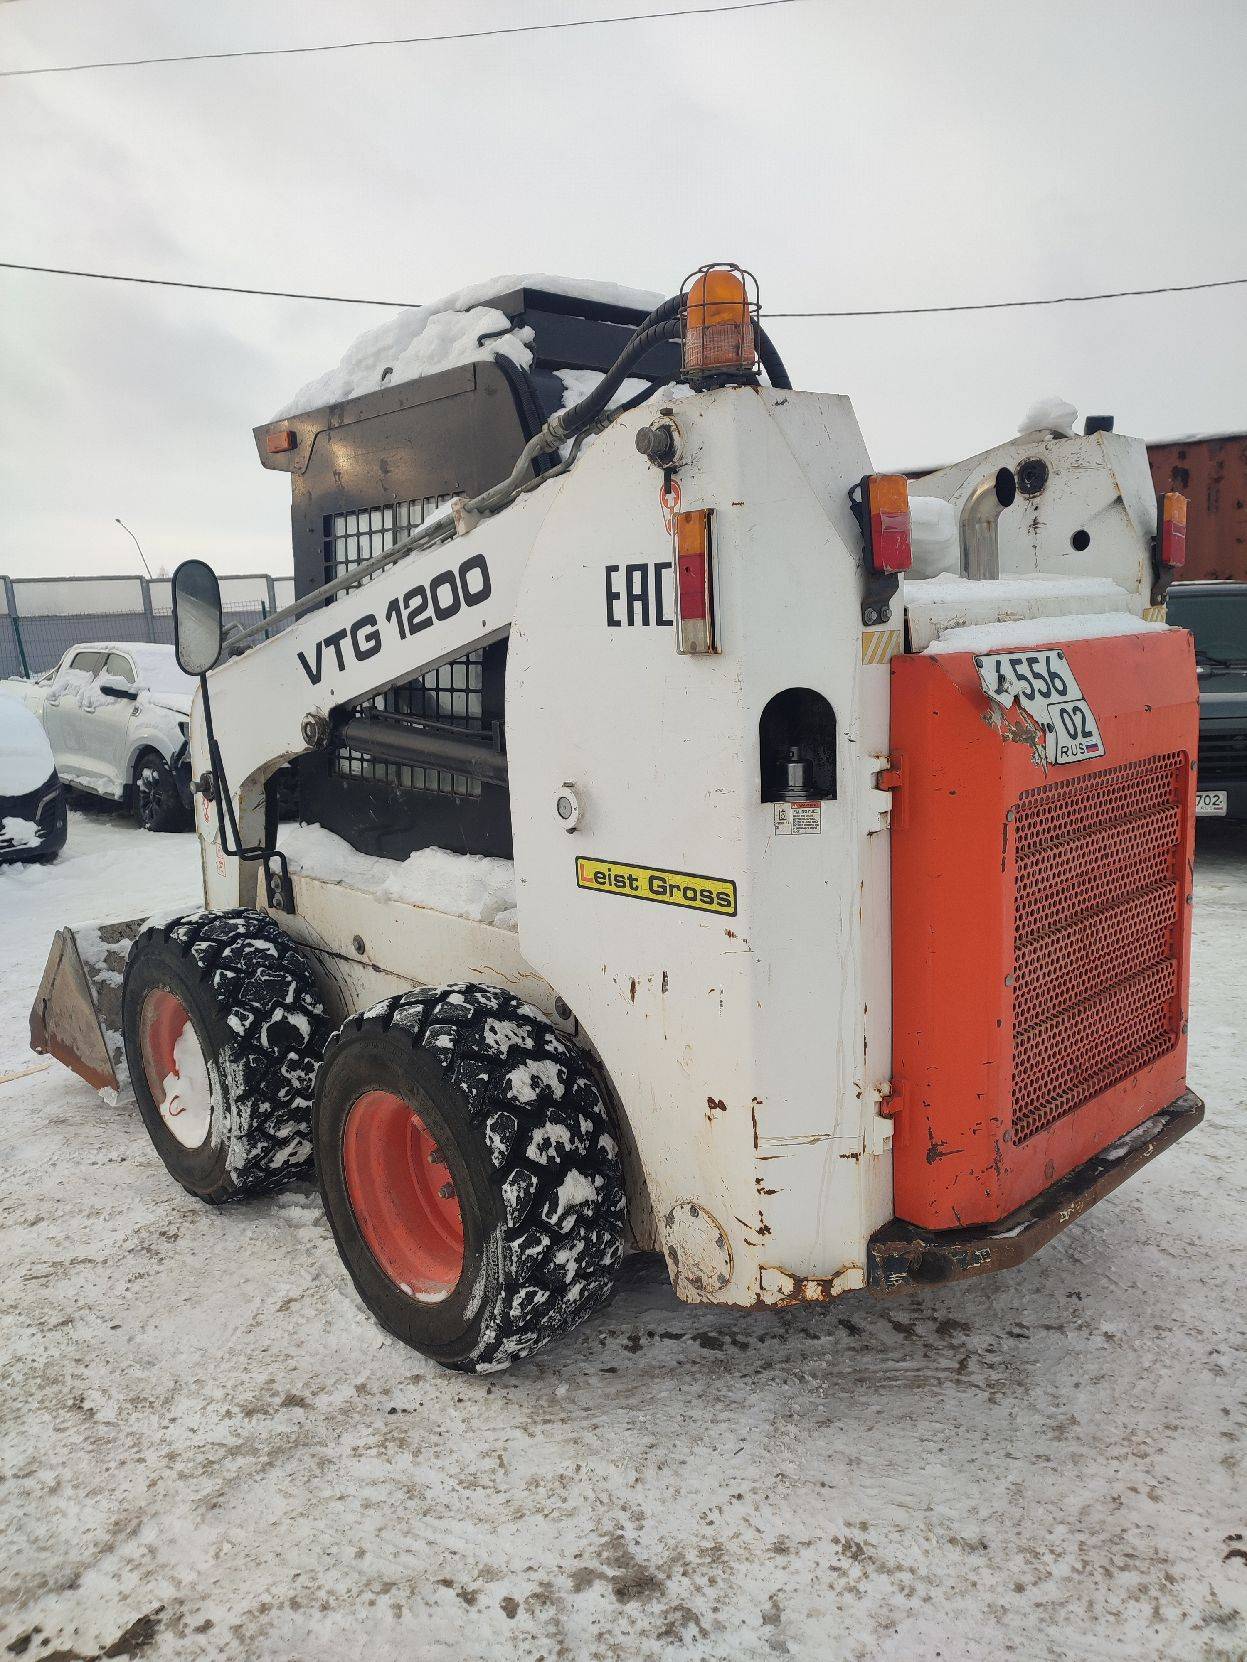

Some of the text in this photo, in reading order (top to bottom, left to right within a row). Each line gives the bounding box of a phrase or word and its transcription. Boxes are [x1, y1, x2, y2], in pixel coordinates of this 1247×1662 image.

[605, 561, 674, 628] EAC
[297, 553, 492, 686] VTG 1200
[1060, 705, 1093, 741] 02
[1060, 741, 1086, 759] RUS
[579, 863, 732, 908] Leist Gross
